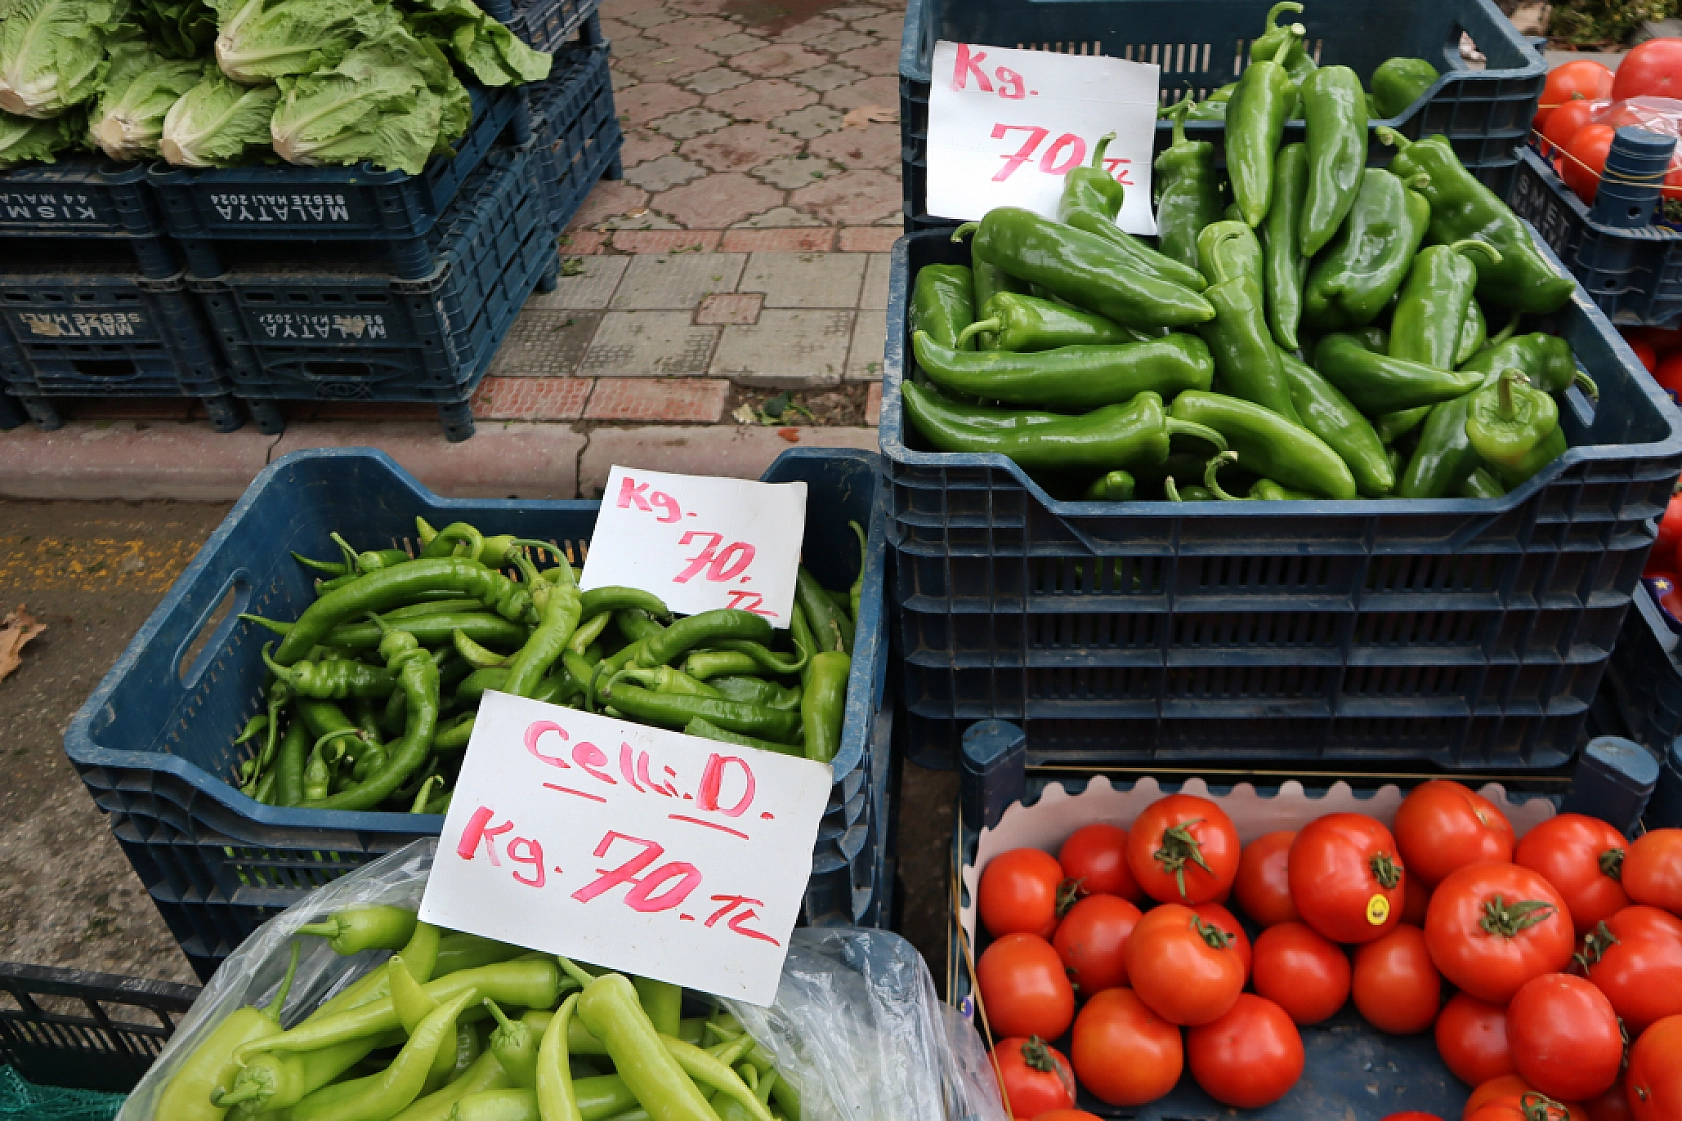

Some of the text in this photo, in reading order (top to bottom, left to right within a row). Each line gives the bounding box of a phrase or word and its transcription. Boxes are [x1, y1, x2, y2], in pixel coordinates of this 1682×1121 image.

[951, 43, 1039, 100] Kg.
[990, 123, 1087, 182] 70
[0, 205, 97, 219] KISM
[63, 193, 88, 205] 44
[210, 193, 249, 205] 2024
[215, 205, 349, 222] MALATYA
[672, 530, 756, 584] 70.
[456, 805, 563, 888] Kg.
[570, 829, 703, 922] 70.
